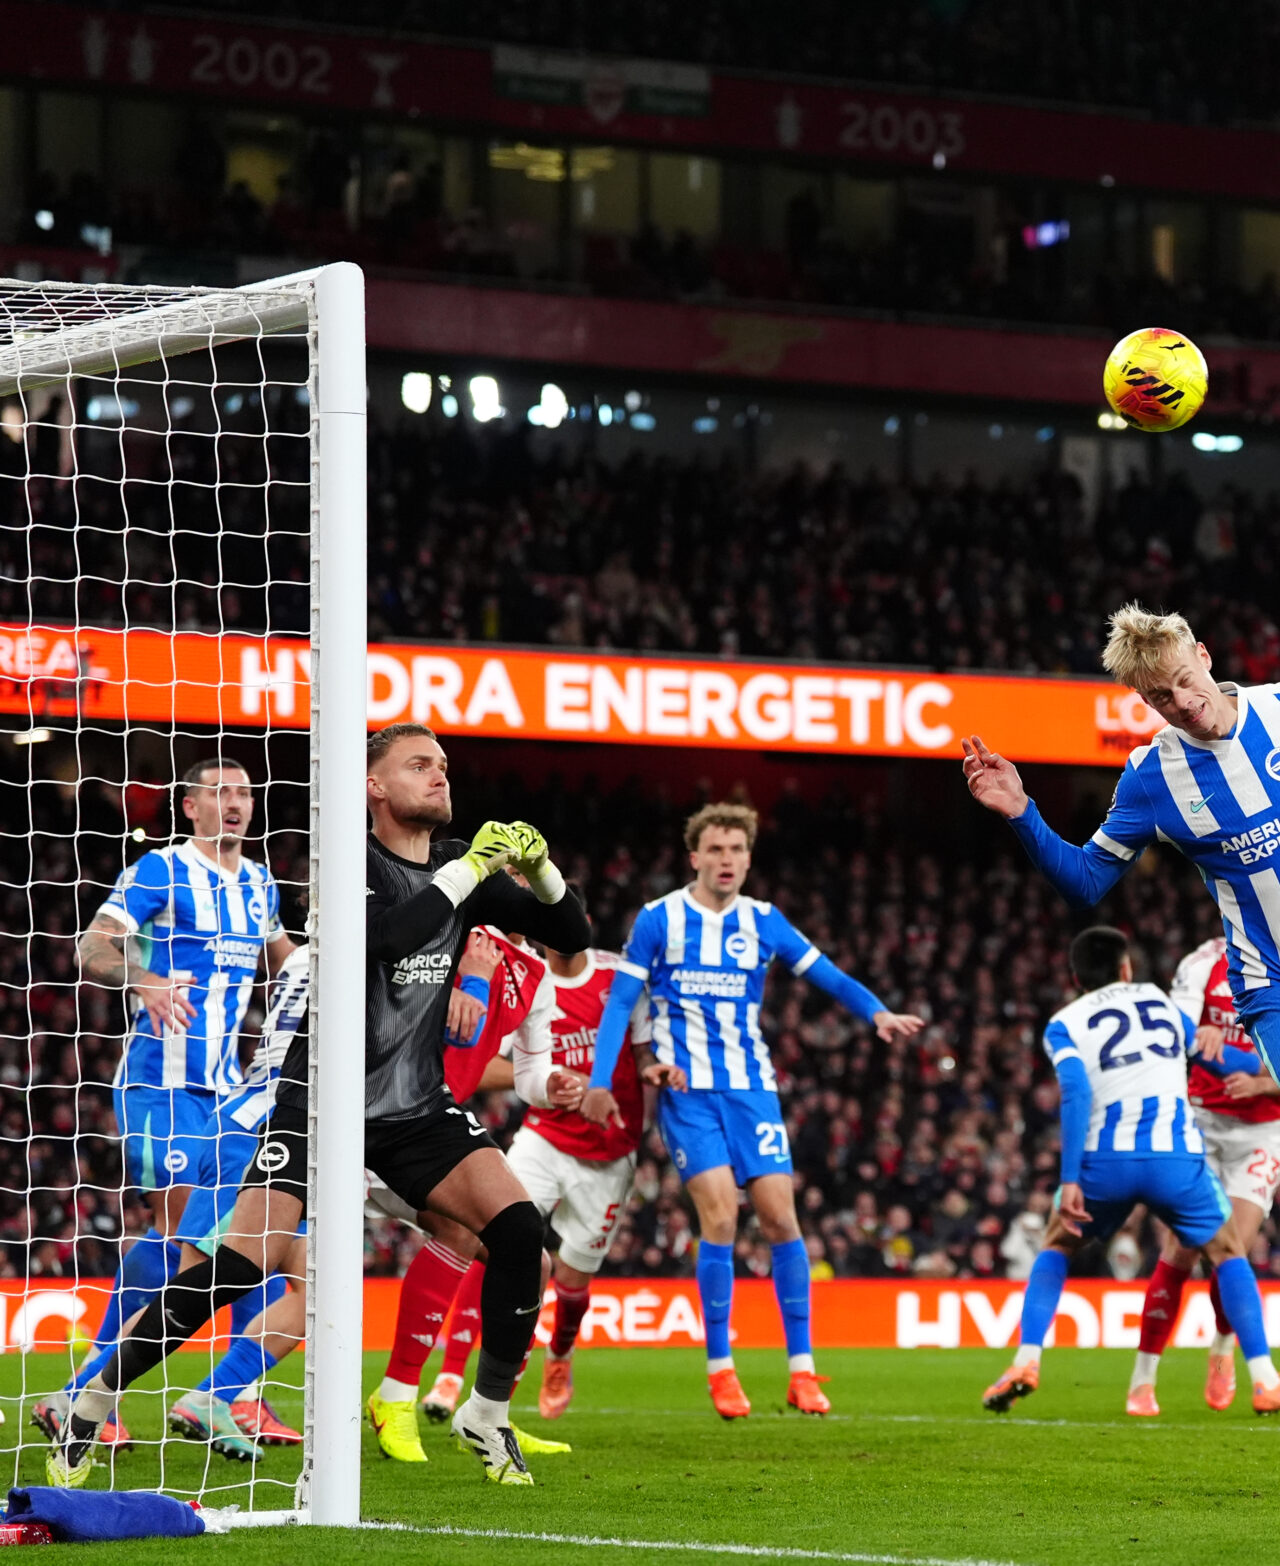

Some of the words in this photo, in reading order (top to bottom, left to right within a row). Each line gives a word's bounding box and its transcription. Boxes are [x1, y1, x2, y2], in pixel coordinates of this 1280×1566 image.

[191, 35, 332, 95] 2002
[838, 101, 967, 156] 2003
[241, 646, 525, 728] HDRA
[545, 662, 953, 749] ENERGETIC
[670, 969, 747, 986] AMERICAN
[680, 982, 746, 997] EXPRESS
[1087, 1000, 1181, 1072] 25
[1247, 1148, 1280, 1185] 23
